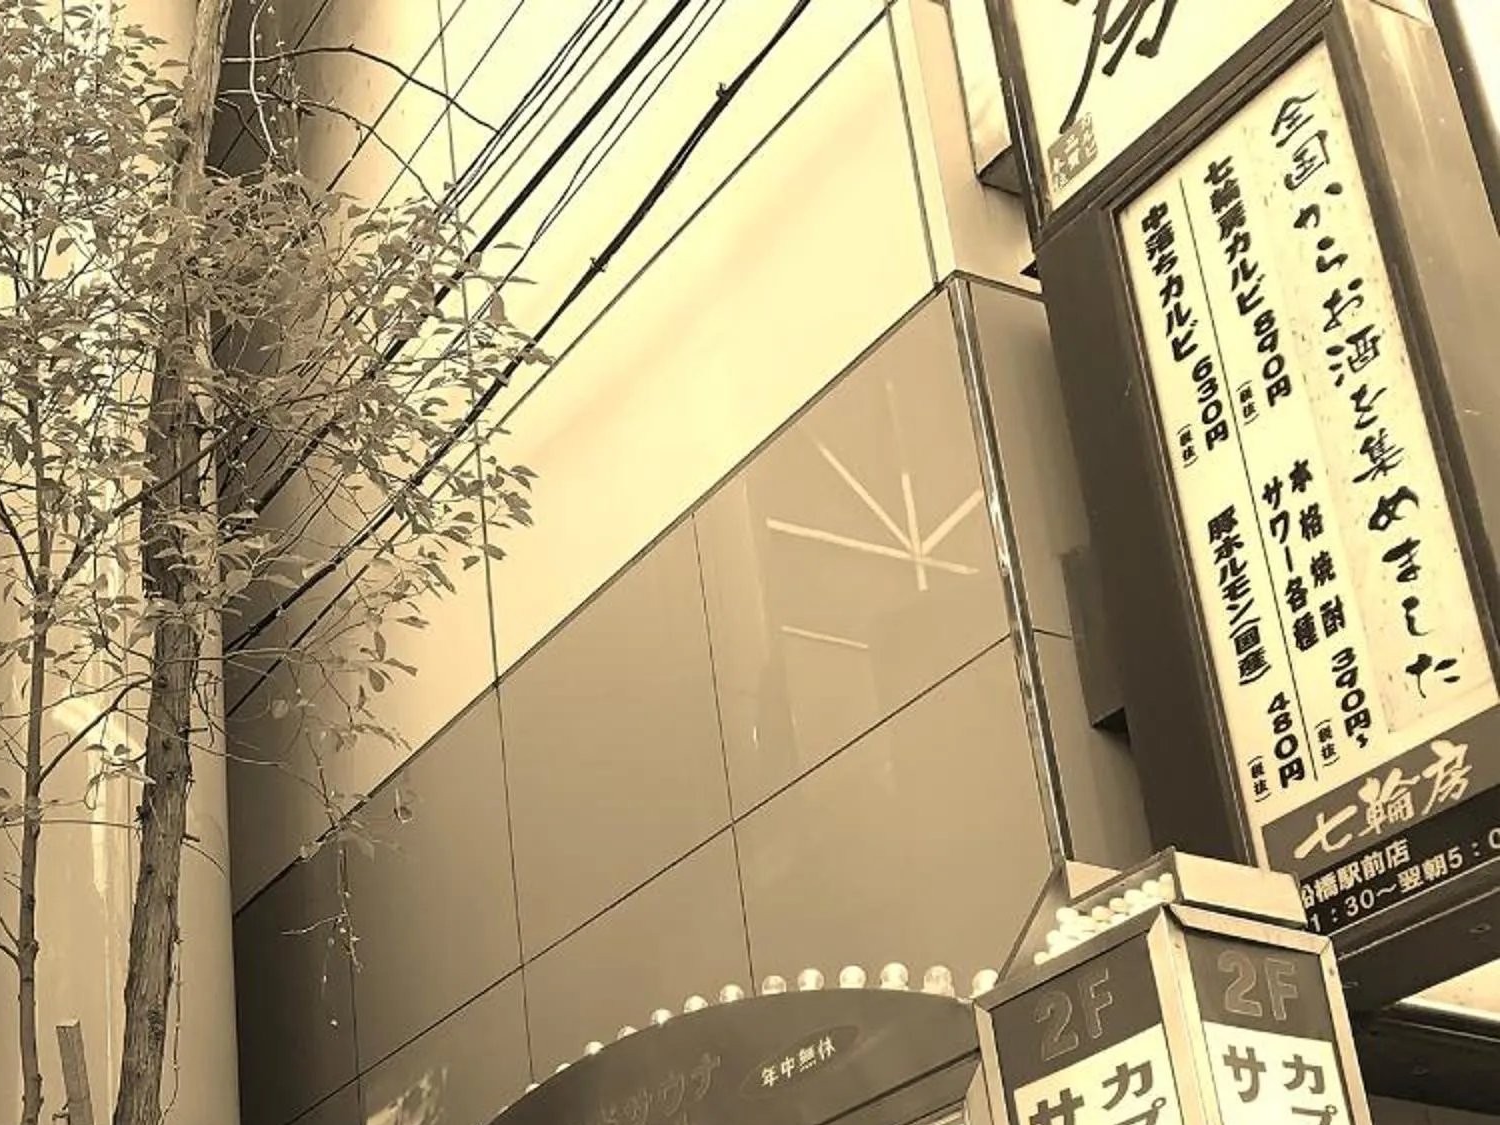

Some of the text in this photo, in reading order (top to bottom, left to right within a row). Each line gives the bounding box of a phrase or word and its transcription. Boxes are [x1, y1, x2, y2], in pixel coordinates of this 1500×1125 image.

[1270, 90, 1462, 700] 全国からお酒を集めました
[1261, 474, 1320, 652] サワー各種
[1288, 457, 1347, 640] 本格焼酎
[1206, 503, 1307, 790] 豚ホルモン(国産) 480円
[1293, 738, 1474, 860] 七輪房
[1035, 966, 1114, 1063] 2F
[1216, 949, 1300, 1022] 2F
[759, 1034, 838, 1089] 年中無休
